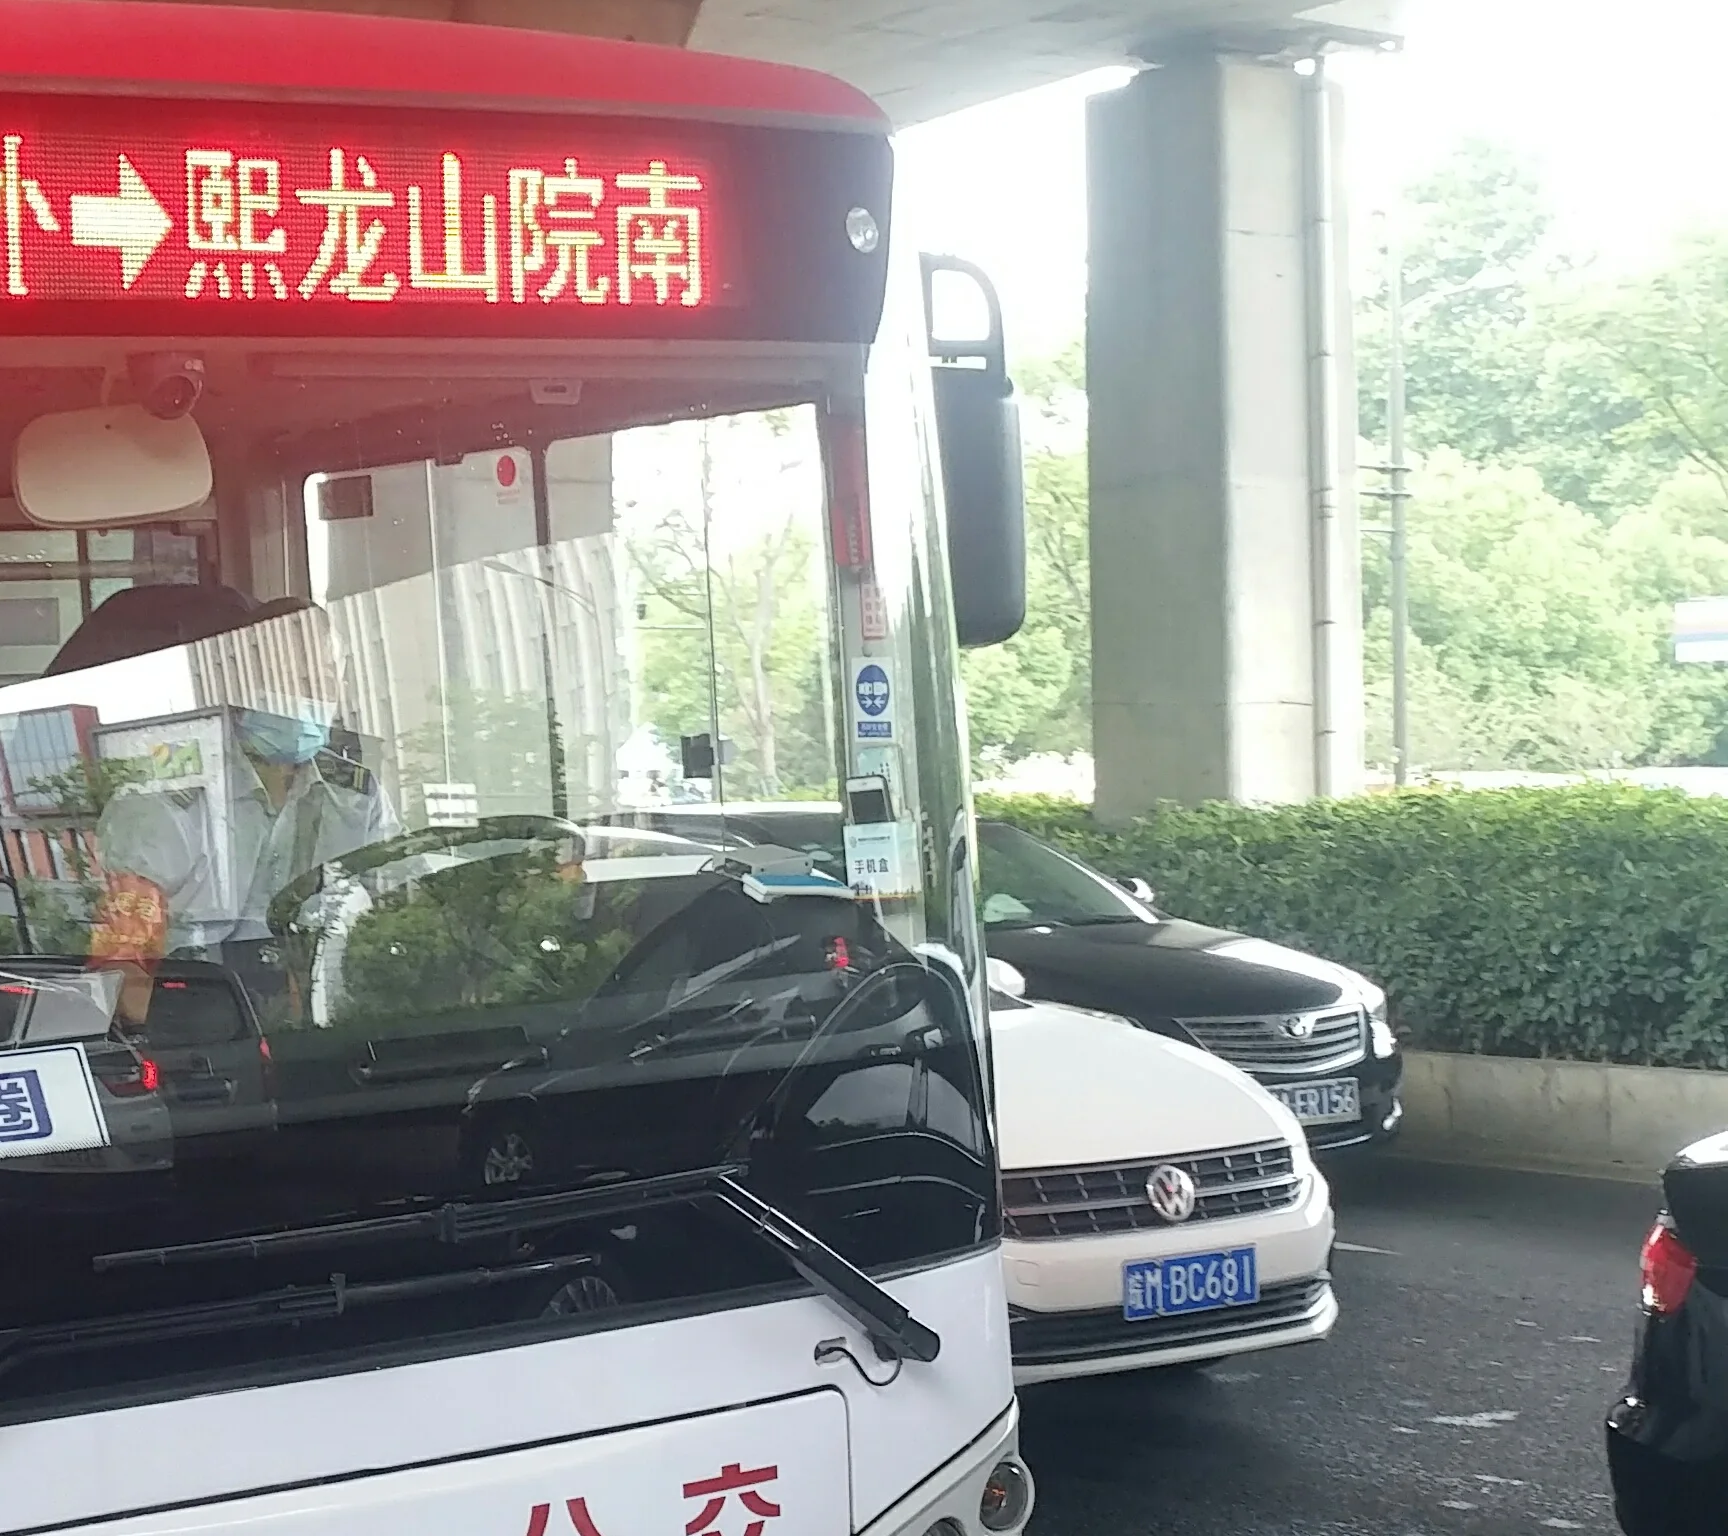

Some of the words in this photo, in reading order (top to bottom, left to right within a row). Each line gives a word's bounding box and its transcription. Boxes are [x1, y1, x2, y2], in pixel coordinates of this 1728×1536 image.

[854, 858, 890, 875] 手机盒
[1273, 1084, 1356, 1118] ER156
